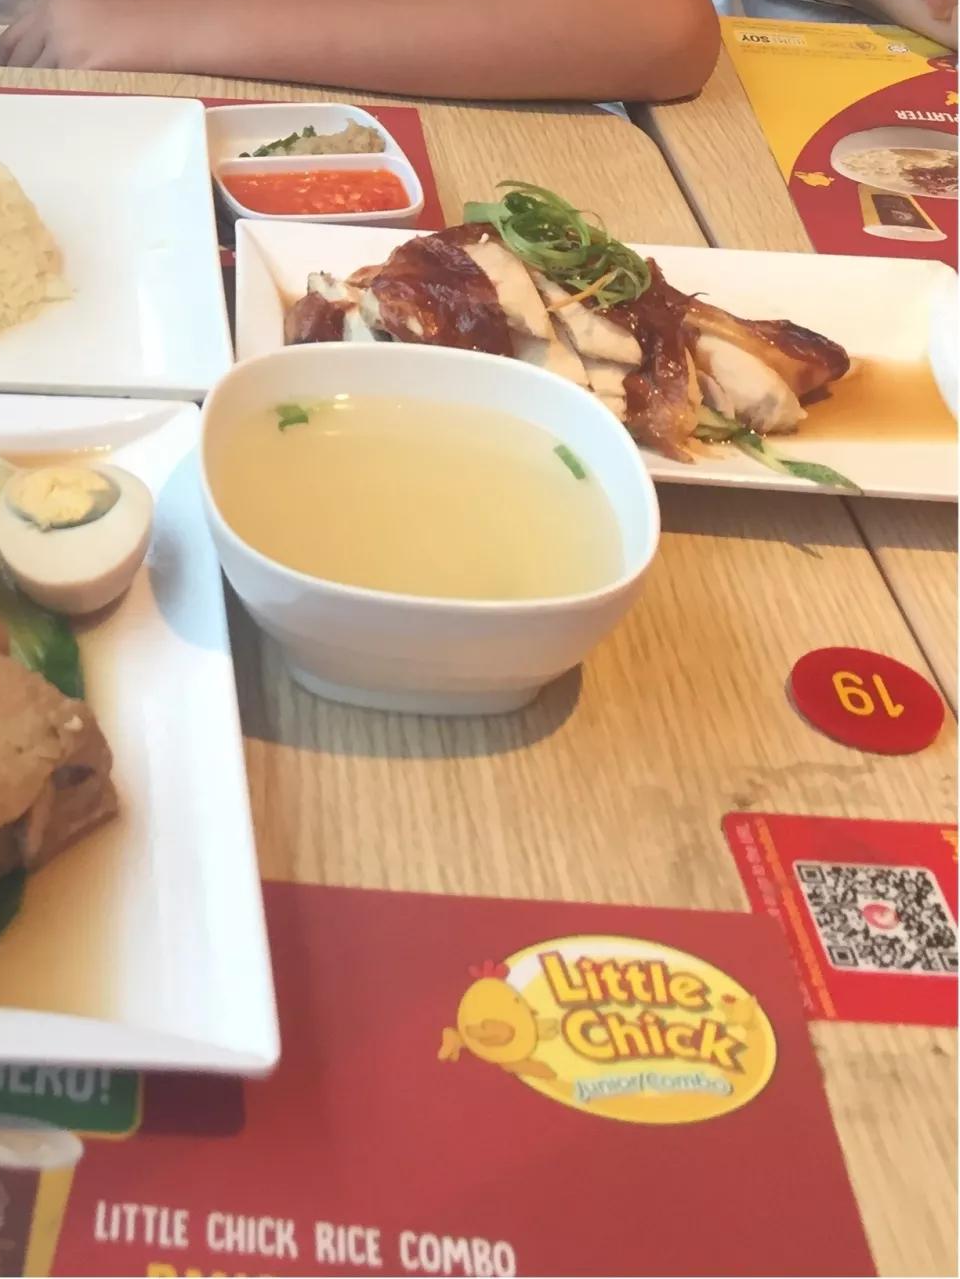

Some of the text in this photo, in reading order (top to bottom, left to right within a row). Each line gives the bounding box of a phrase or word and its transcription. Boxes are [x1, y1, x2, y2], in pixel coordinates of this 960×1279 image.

[538, 950, 713, 1012] Little
[561, 1007, 747, 1075] Chick
[94, 1199, 517, 1277] LITTLE CHICK RICE COMBO
